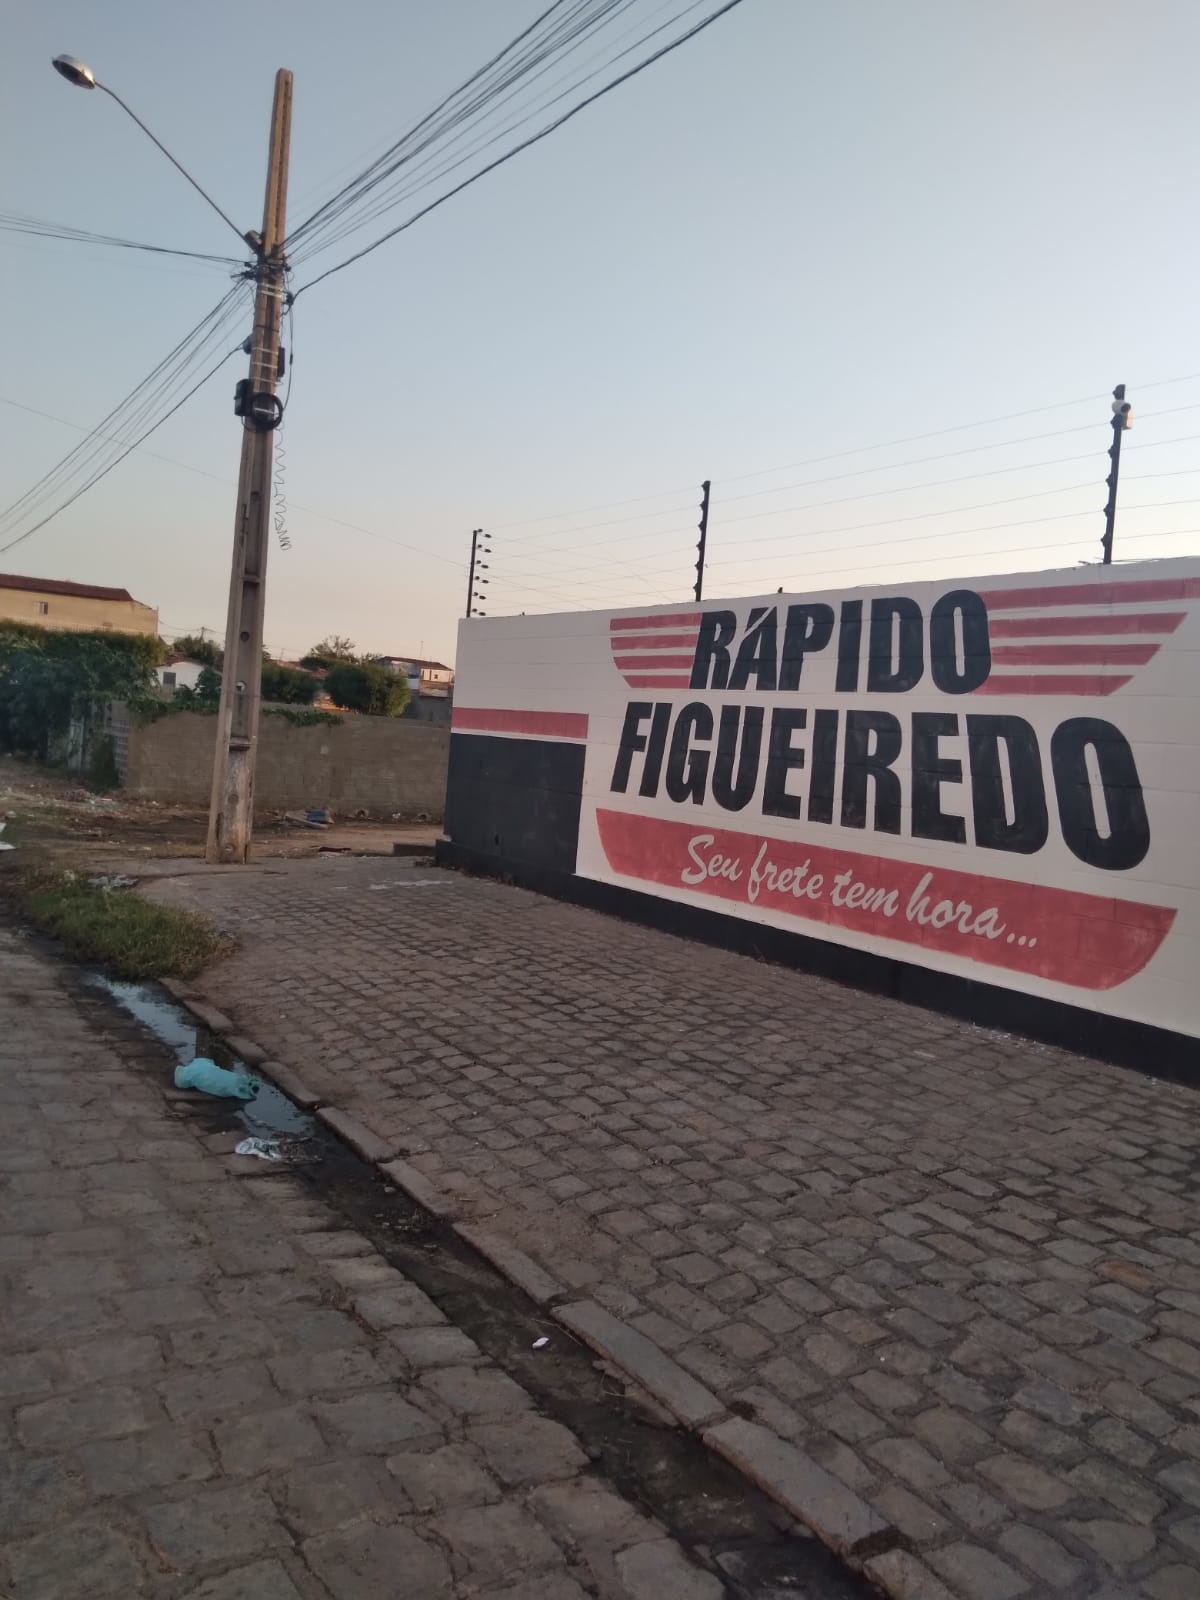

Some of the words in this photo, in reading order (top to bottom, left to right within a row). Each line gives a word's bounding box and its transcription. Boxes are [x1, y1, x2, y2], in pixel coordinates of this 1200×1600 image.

[689, 589, 992, 694] RÁPIDO
[610, 701, 1151, 871] FIGUEIREDO
[682, 834, 741, 884] Seu
[744, 841, 823, 903] frete
[830, 869, 898, 916] tem
[905, 874, 1037, 948] hora...
